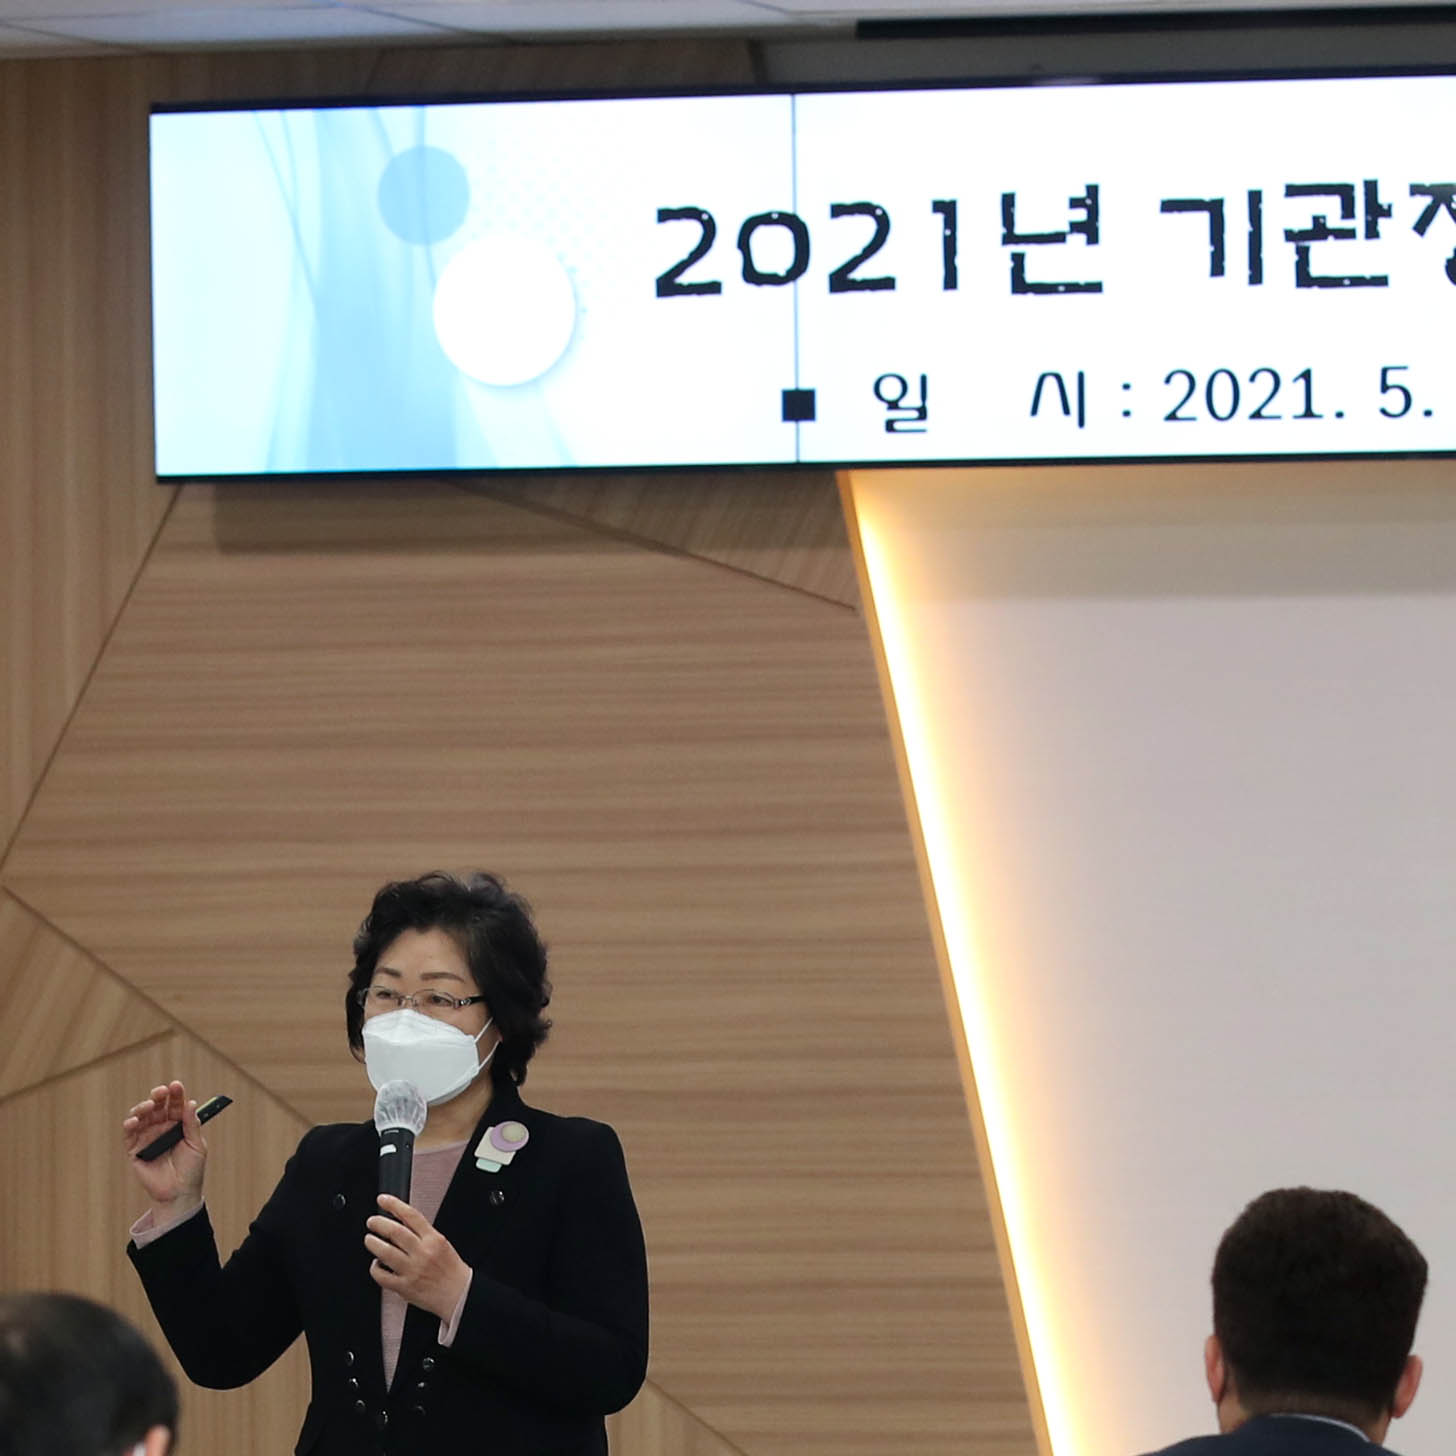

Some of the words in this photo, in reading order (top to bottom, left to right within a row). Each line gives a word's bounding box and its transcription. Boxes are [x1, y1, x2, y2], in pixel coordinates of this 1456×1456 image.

[655, 184, 1103, 298] 2021년
[1163, 367, 1346, 422] 2021.
[1379, 366, 1433, 419] 5.
